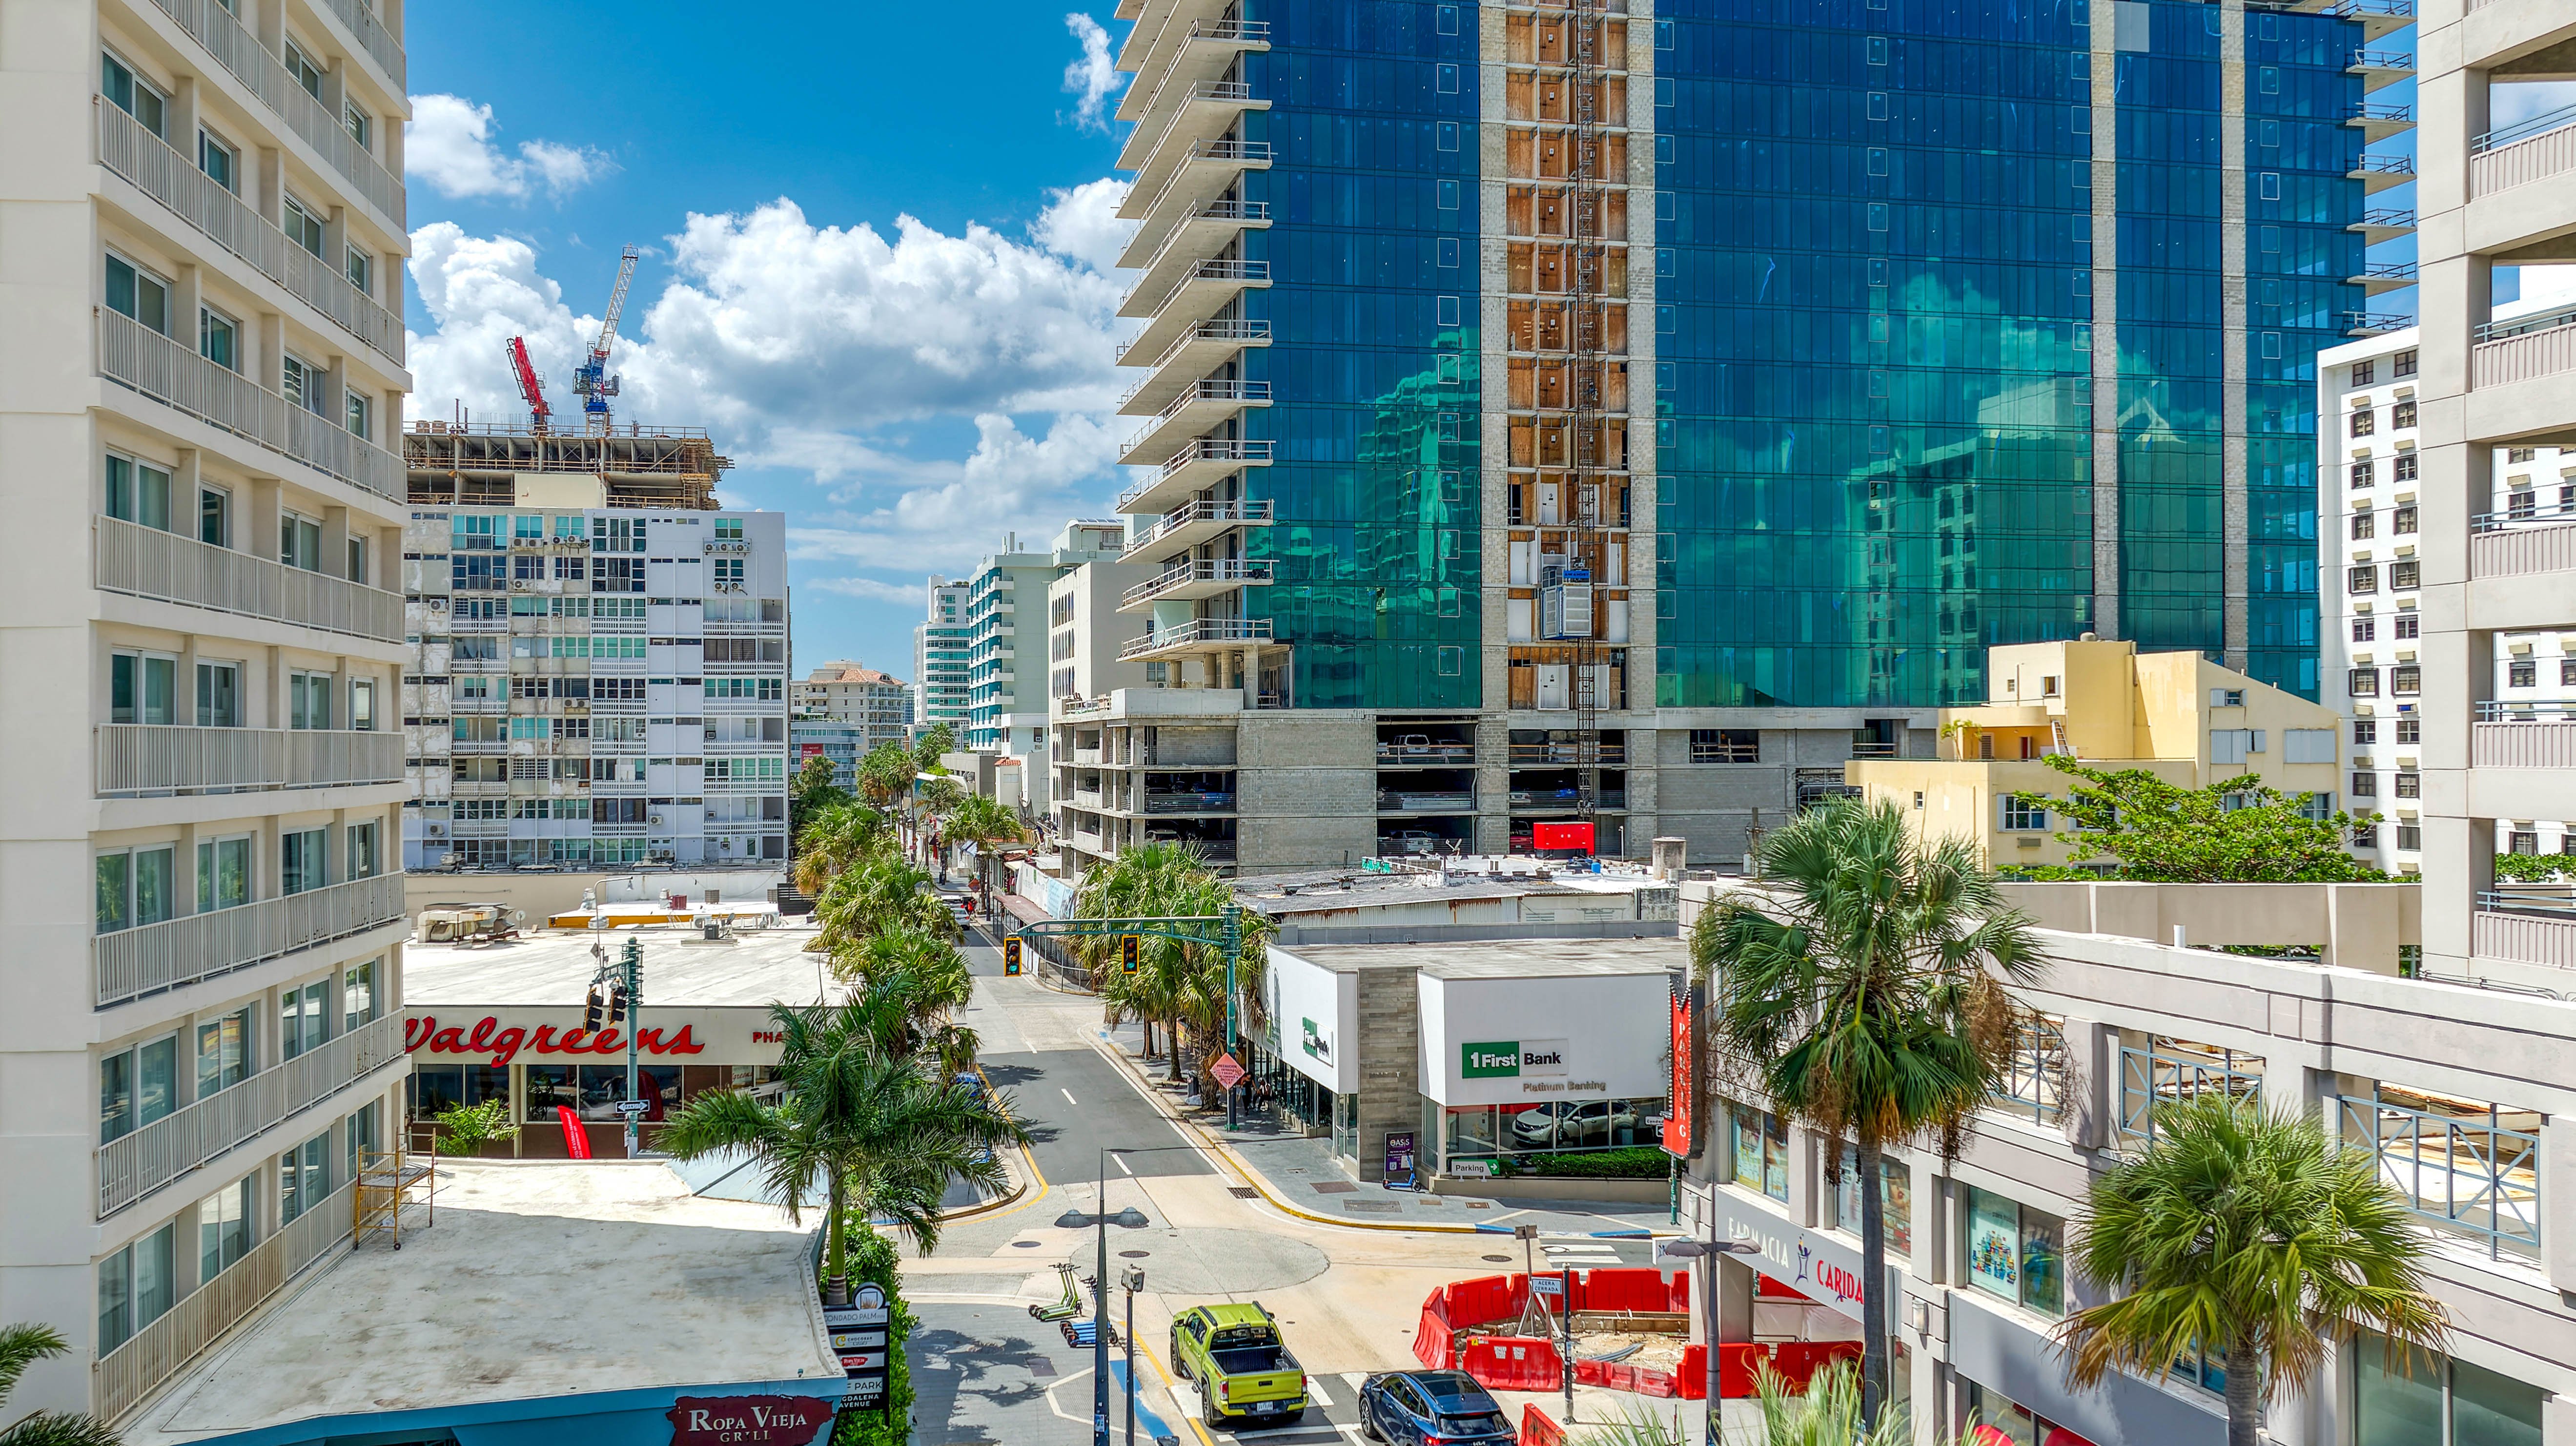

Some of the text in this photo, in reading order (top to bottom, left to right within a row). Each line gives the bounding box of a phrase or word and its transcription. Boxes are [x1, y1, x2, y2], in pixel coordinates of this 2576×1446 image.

[406, 1015, 705, 1068] Walgreens
[1524, 1052, 1562, 1065] Bank
[1523, 1081, 1606, 1093] Platinum Banking
[855, 1382, 882, 1390] PARK
[720, 1430, 772, 1443] GRILL
